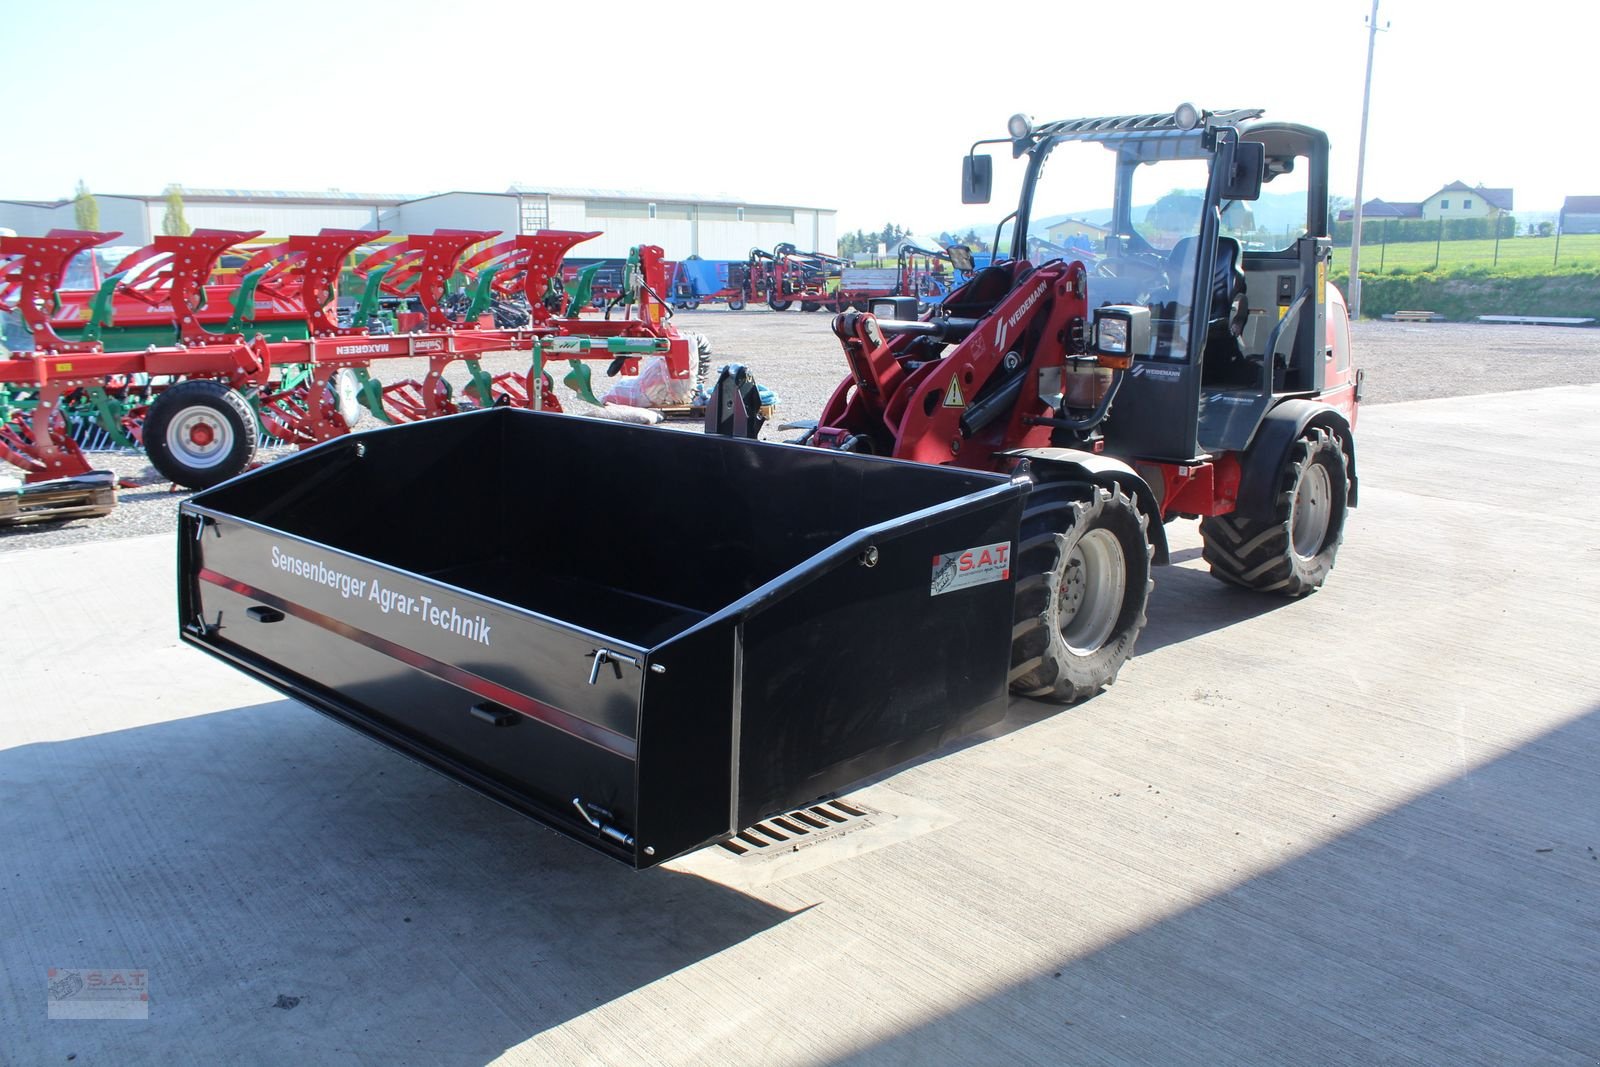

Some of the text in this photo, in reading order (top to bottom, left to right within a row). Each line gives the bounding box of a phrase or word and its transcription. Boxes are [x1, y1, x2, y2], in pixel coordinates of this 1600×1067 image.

[1008, 280, 1047, 327] WEIDEMANN
[336, 344, 389, 355] MAXGREEN
[1145, 368, 1180, 377] WEIDEMANN
[271, 546, 491, 646] Sensenberger Agrar-Technik
